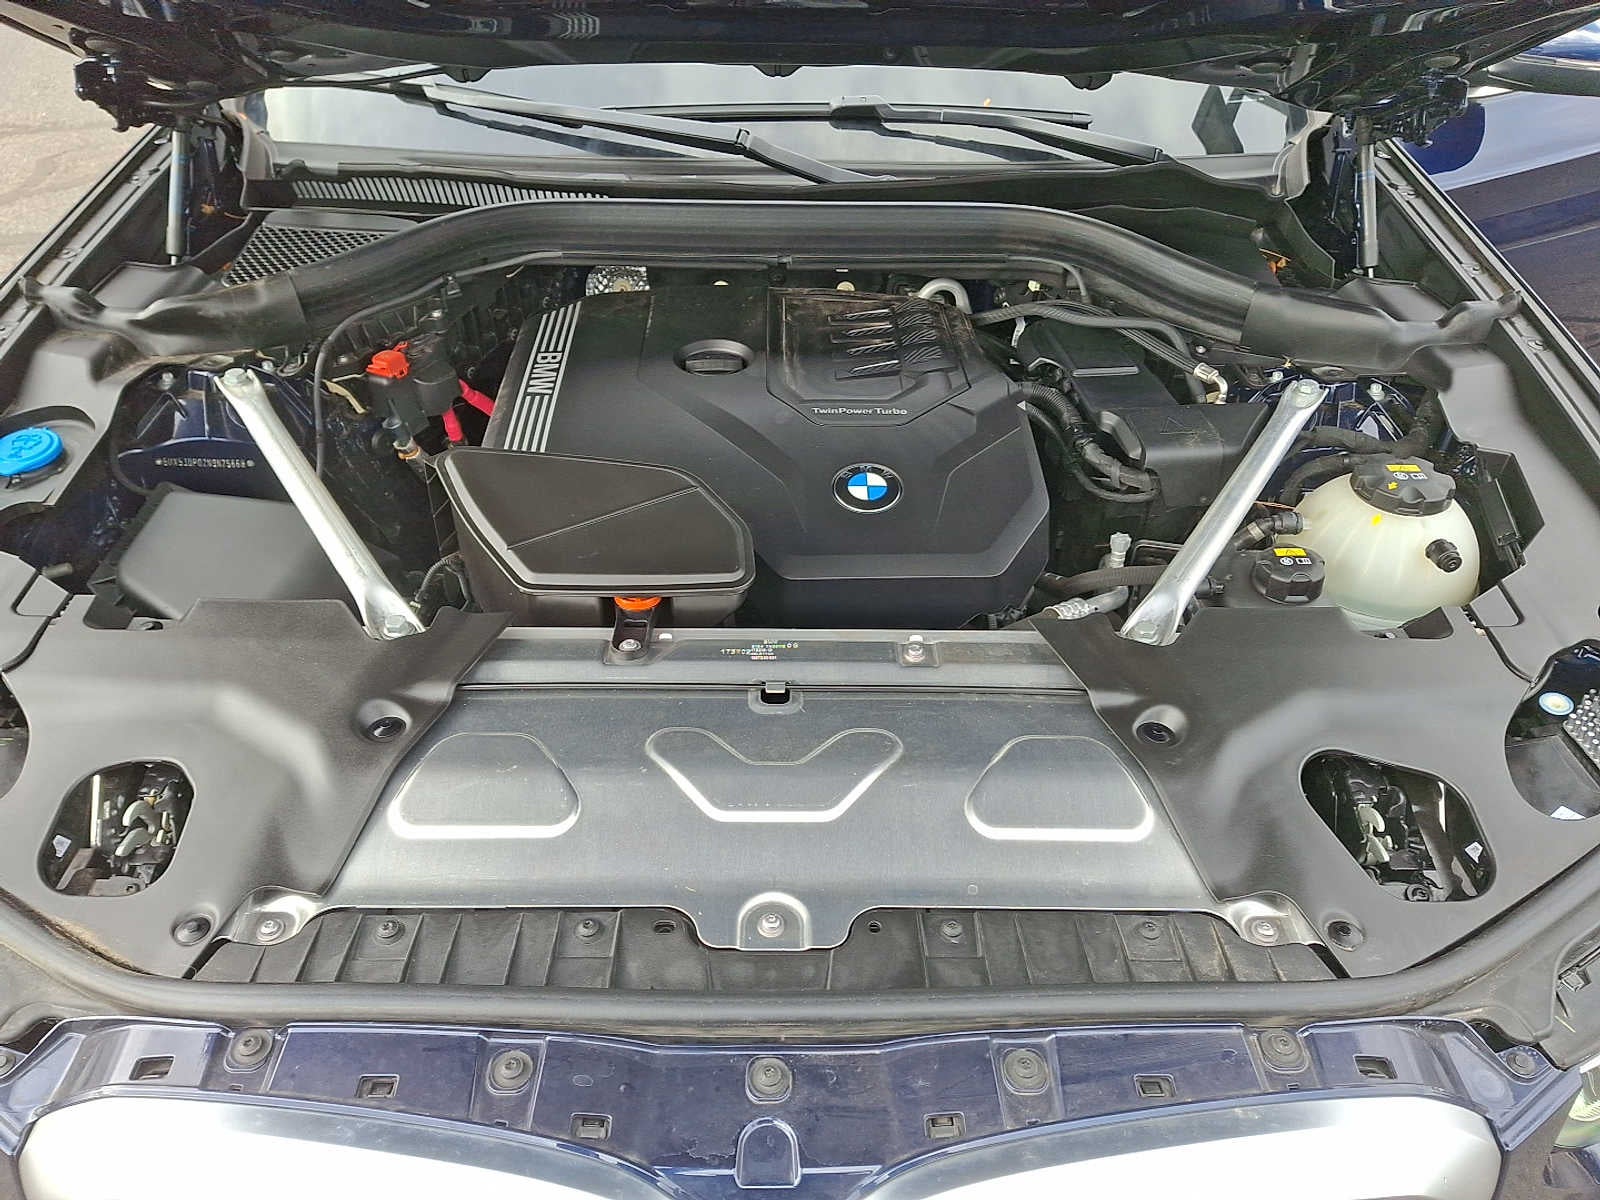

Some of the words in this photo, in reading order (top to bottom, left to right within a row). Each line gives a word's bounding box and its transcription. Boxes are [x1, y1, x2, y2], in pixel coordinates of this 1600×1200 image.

[526, 352, 563, 395] BMW
[811, 407, 873, 415] TwinPower
[874, 407, 908, 415] Turbo
